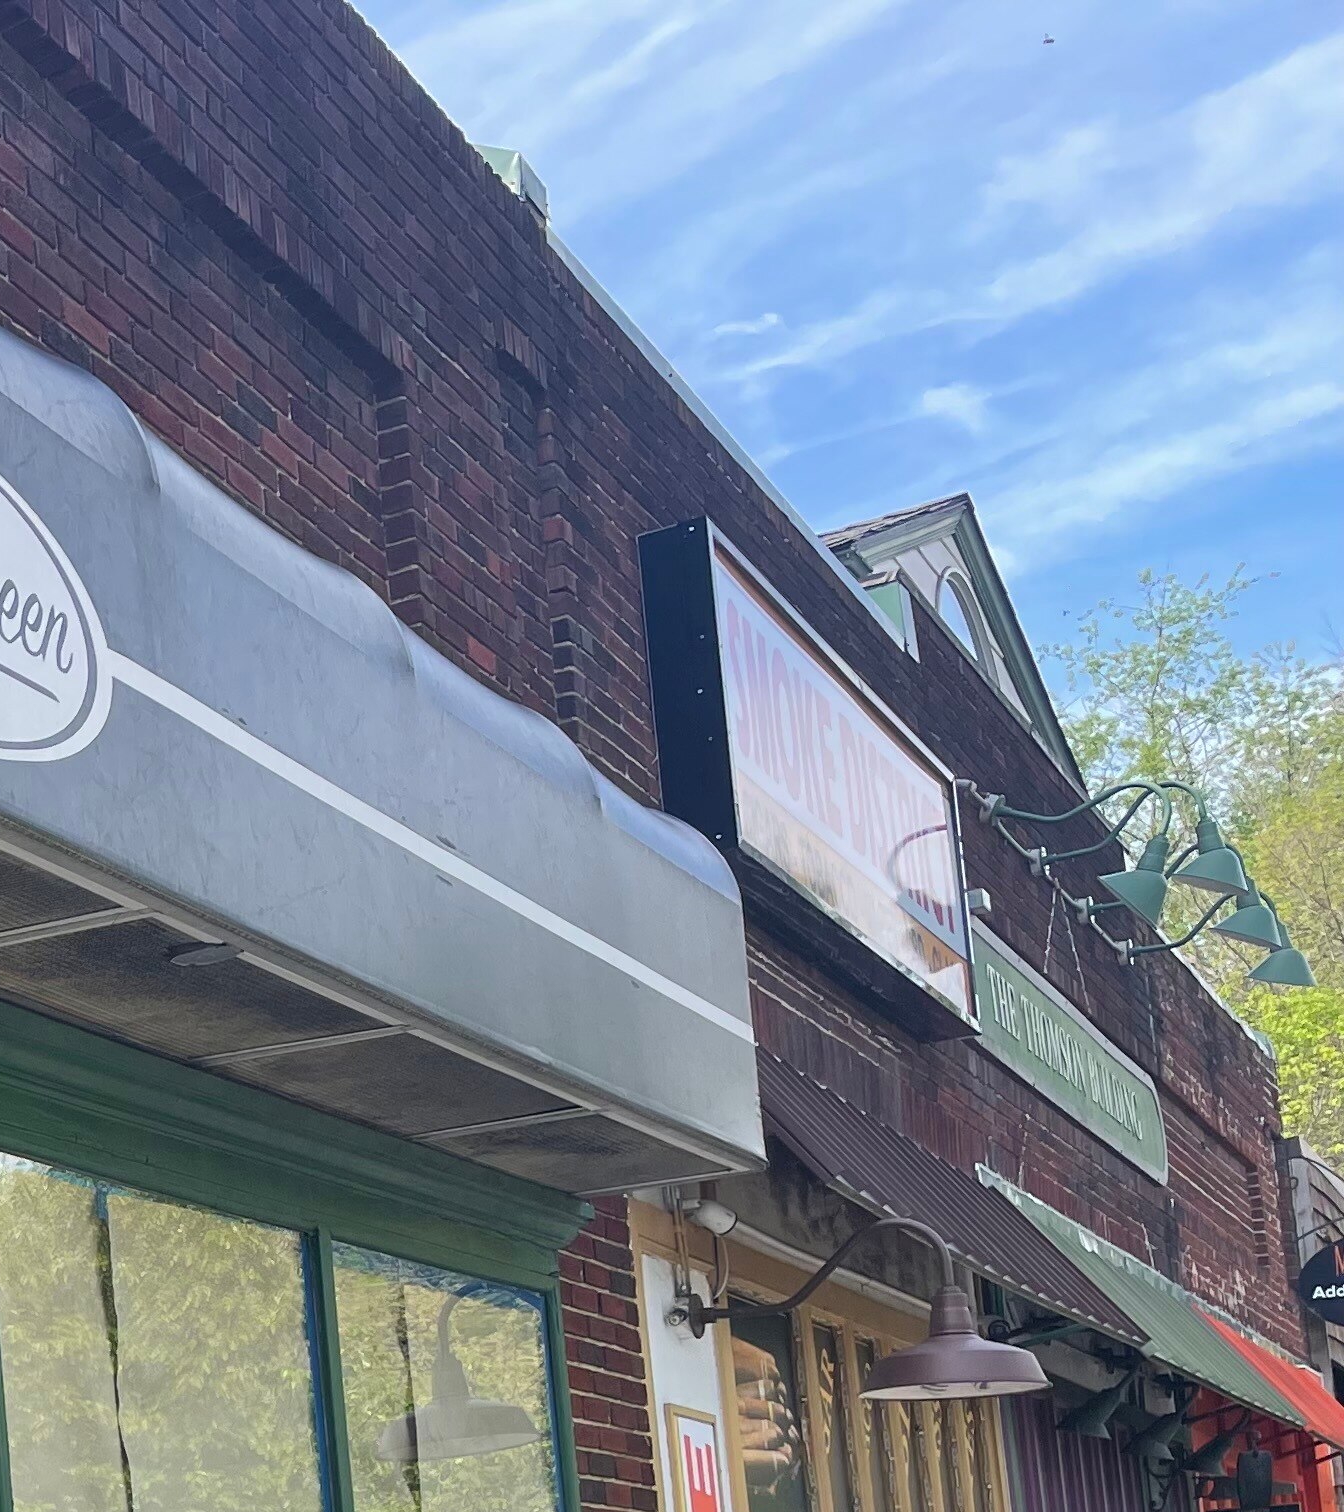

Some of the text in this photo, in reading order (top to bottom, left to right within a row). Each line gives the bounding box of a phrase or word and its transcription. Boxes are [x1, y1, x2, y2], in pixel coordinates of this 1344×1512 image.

[725, 598, 843, 840] SMOKE
[987, 963, 1143, 1141] THE THOMSON BUILDING
